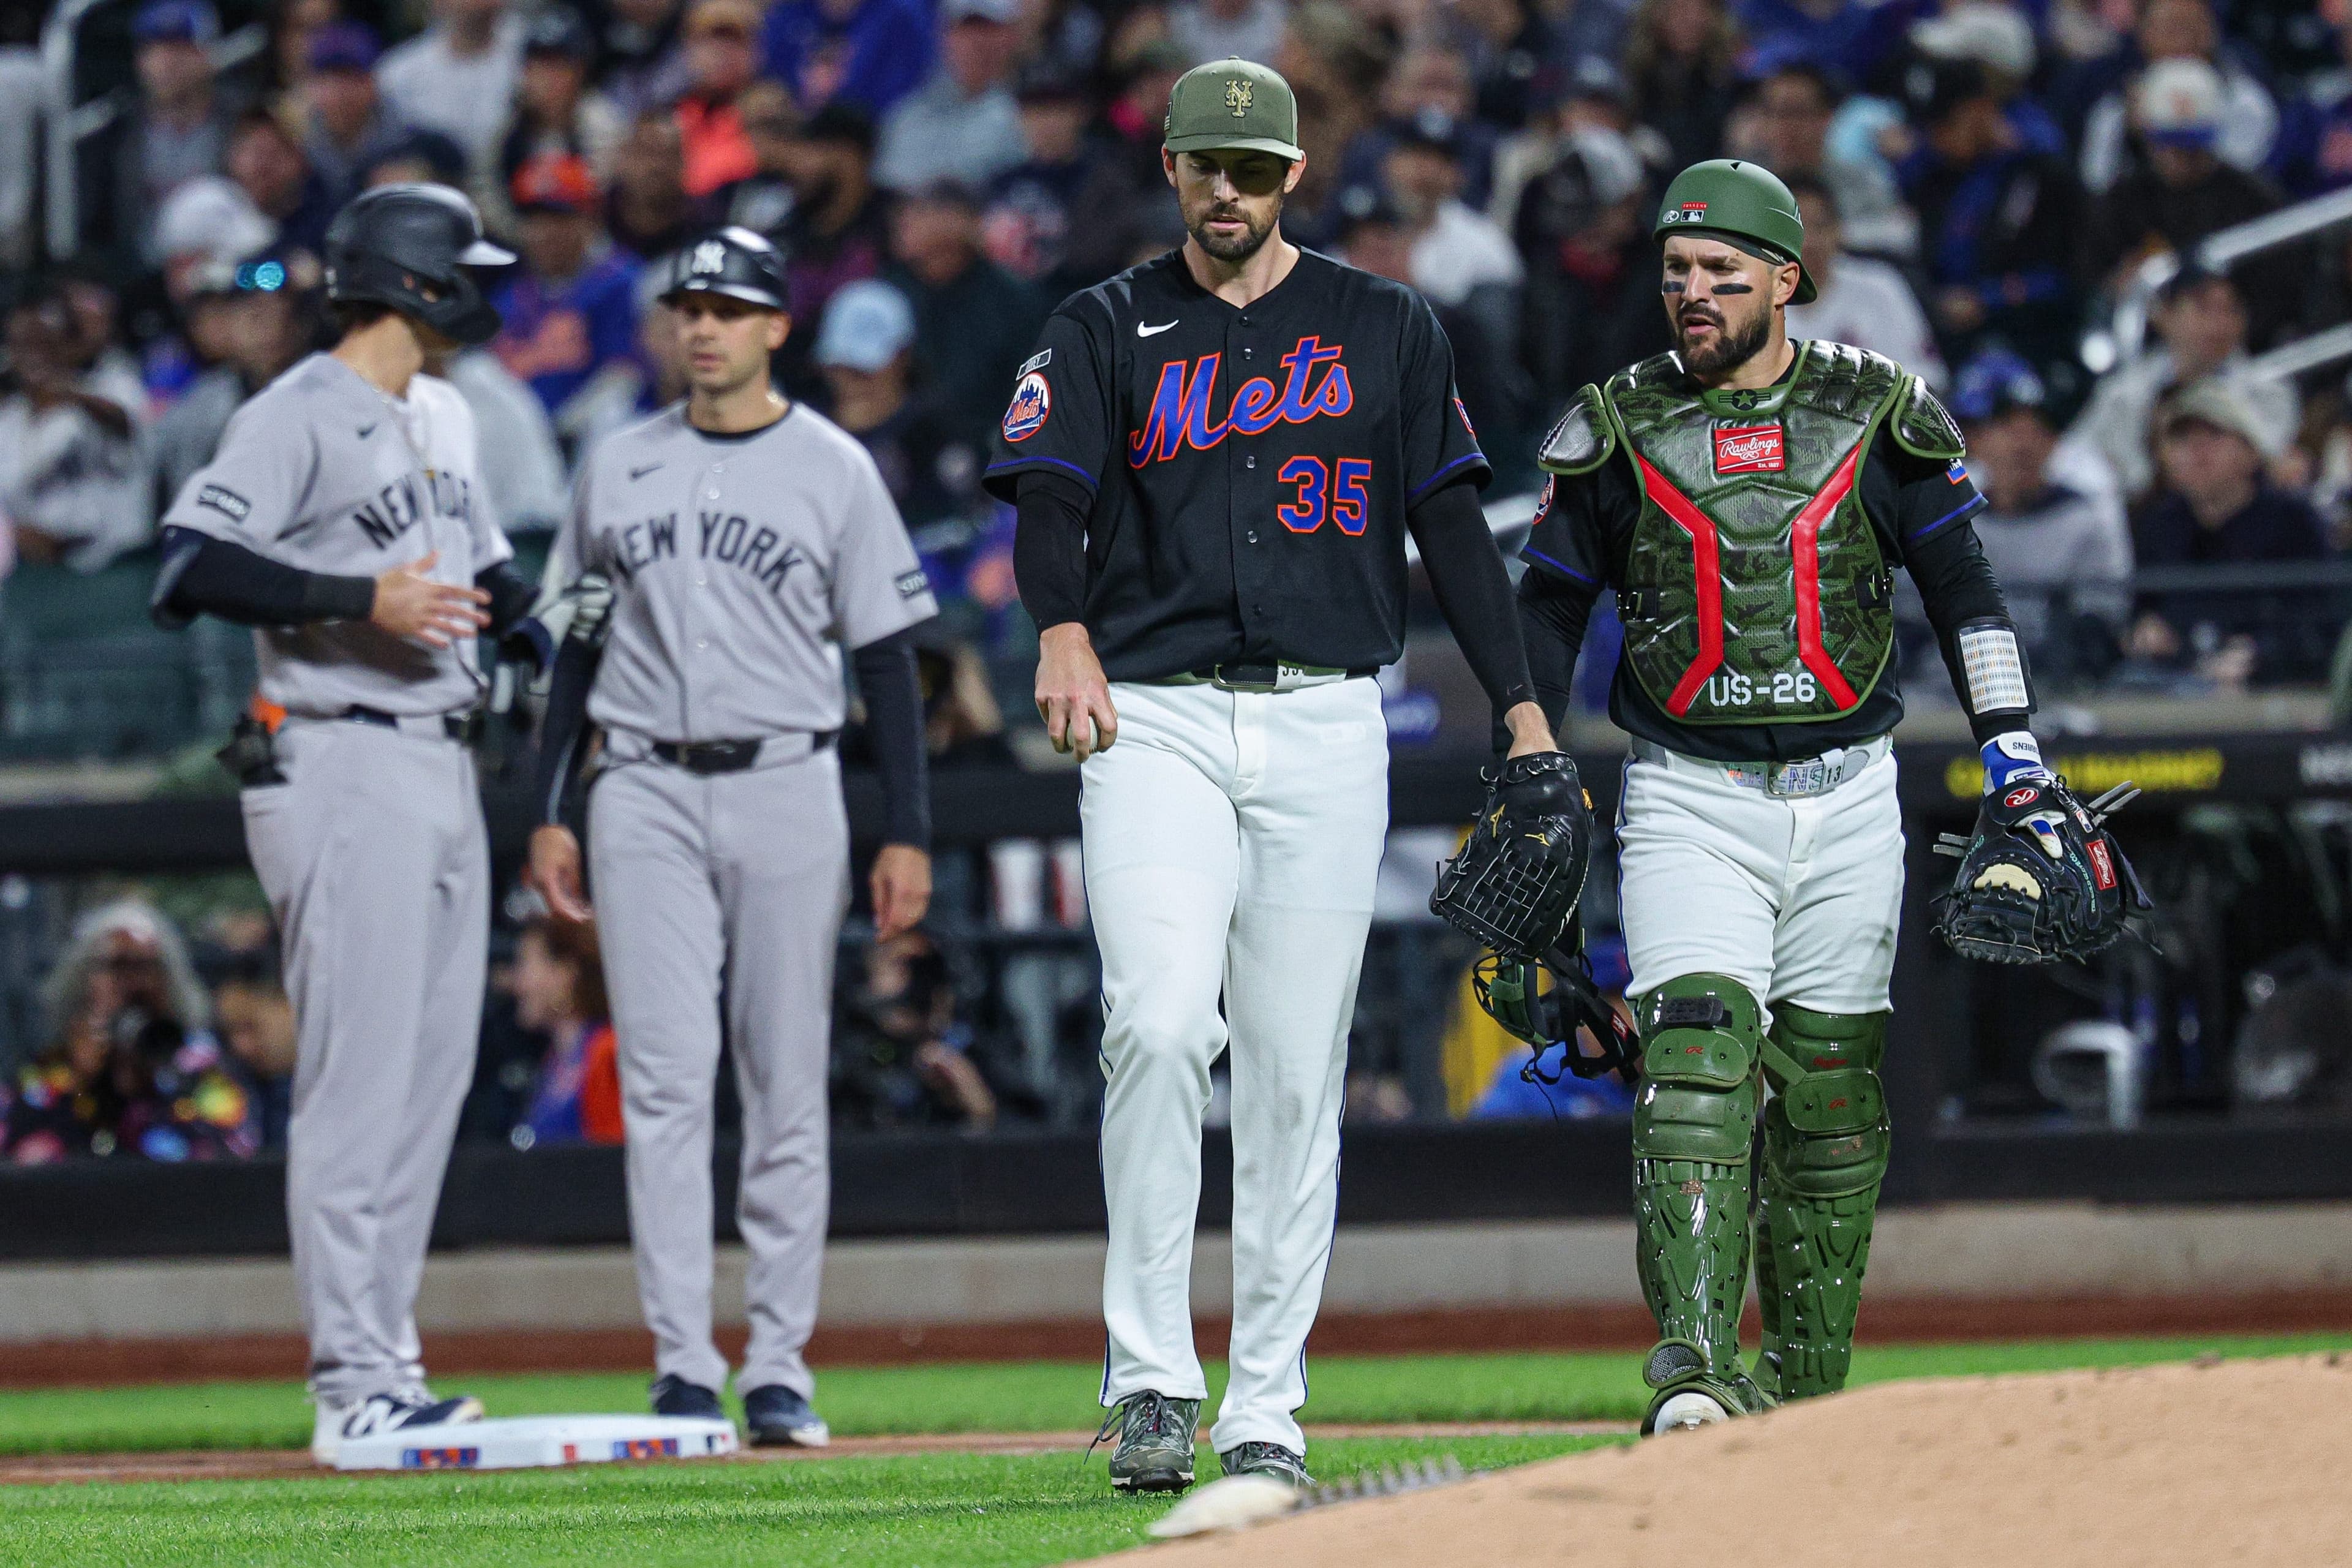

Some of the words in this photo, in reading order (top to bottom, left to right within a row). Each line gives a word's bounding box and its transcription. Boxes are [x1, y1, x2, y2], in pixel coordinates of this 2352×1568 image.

[1225, 80, 1253, 118] NY
[1007, 396, 1041, 427] Mets
[1129, 336, 1354, 470] Mets
[1720, 437, 1780, 458] Rawlings
[1277, 455, 1373, 537] 35
[701, 512, 802, 594] YORK
[1709, 672, 1817, 707] US-26
[1826, 765, 1842, 785] 13
